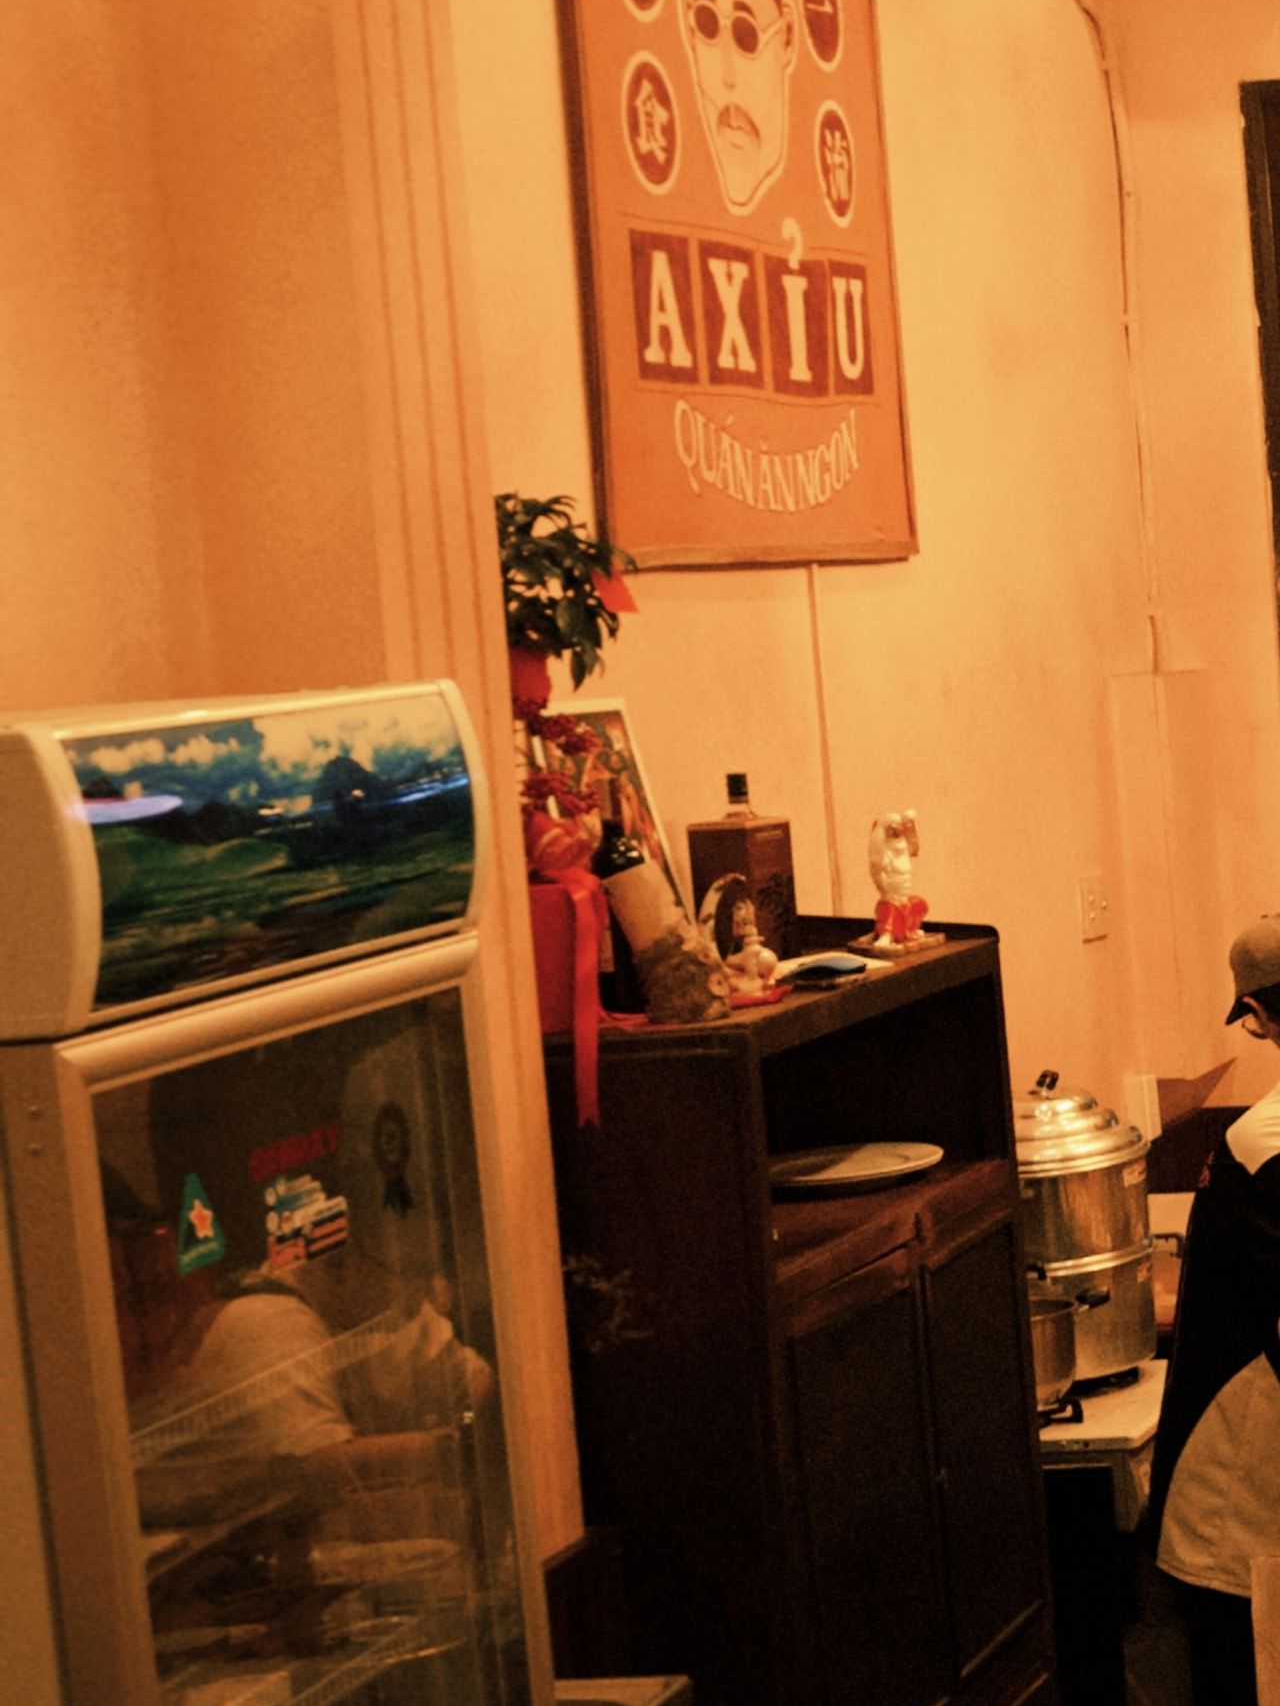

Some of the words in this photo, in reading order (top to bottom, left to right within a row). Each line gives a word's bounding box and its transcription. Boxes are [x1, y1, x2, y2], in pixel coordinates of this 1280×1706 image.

[644, 217, 864, 382] AXỈU
[674, 400, 755, 506] QUÁN
[757, 439, 797, 511] ĂN
[798, 408, 858, 506] NGON
